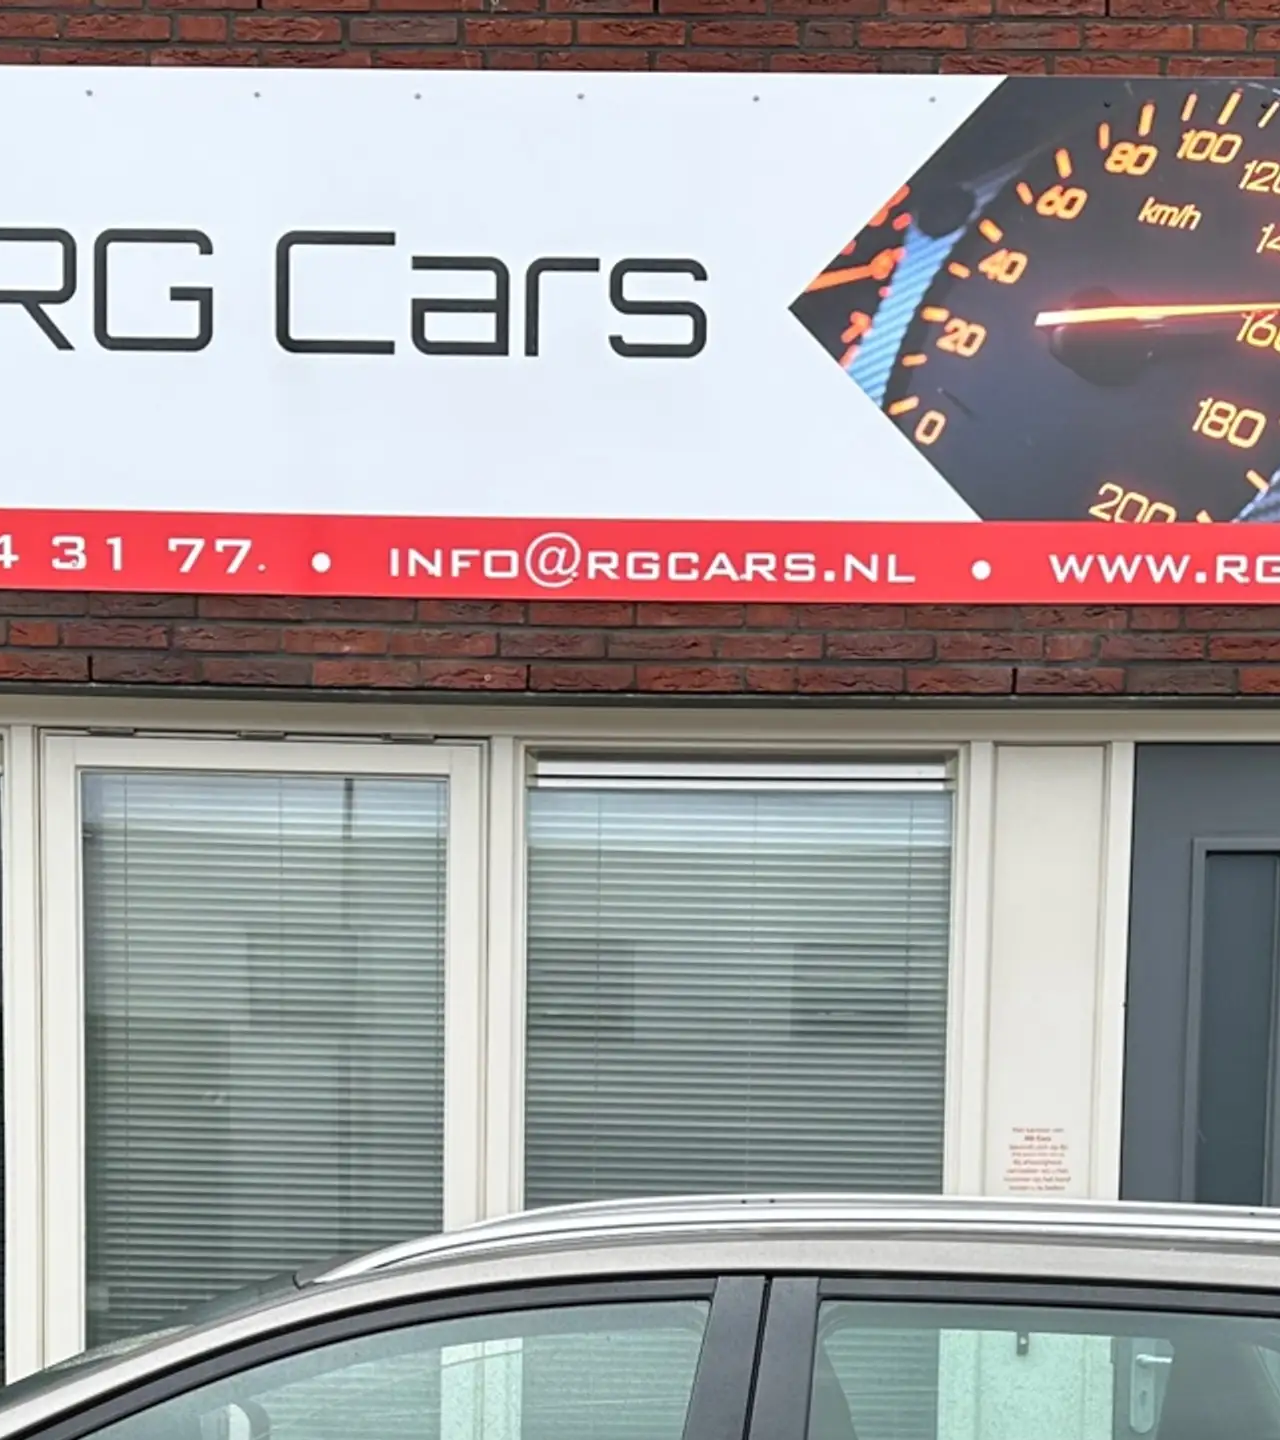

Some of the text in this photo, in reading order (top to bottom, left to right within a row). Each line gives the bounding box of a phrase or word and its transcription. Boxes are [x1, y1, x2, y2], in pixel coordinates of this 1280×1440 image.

[1103, 141, 1158, 175] 80
[1176, 129, 1243, 164] 100
[1035, 184, 1088, 220] 60
[1137, 197, 1202, 231] km/h
[978, 249, 1028, 284] 40
[275, 230, 708, 359] Cars
[935, 317, 987, 357] 20
[915, 410, 946, 445] 0
[1192, 397, 1266, 448] 180
[51, 535, 122, 571] 31
[390, 532, 916, 588] INFO@RGCARS.NL
